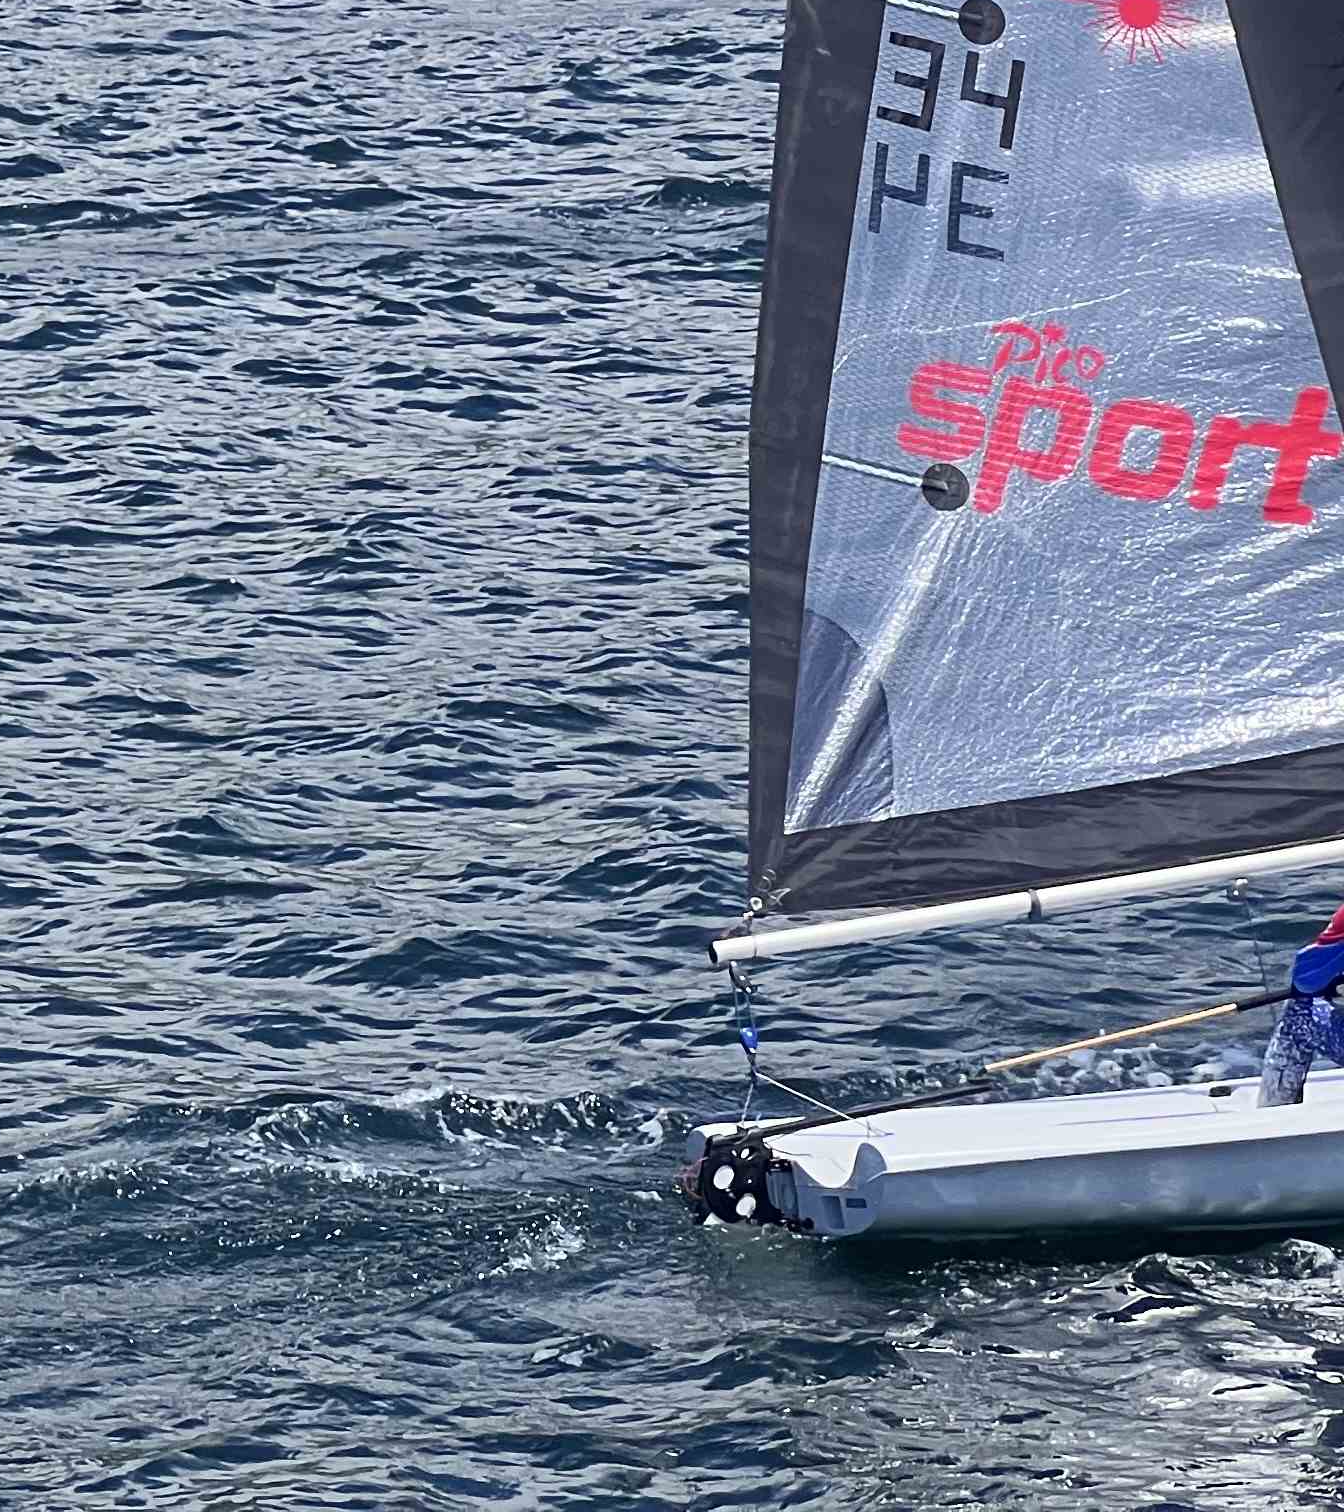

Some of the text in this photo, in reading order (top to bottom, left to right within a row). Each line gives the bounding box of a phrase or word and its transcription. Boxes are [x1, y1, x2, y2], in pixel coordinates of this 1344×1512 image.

[877, 31, 1025, 149] 34
[989, 321, 1105, 385] Pico
[897, 361, 1344, 526] sport
